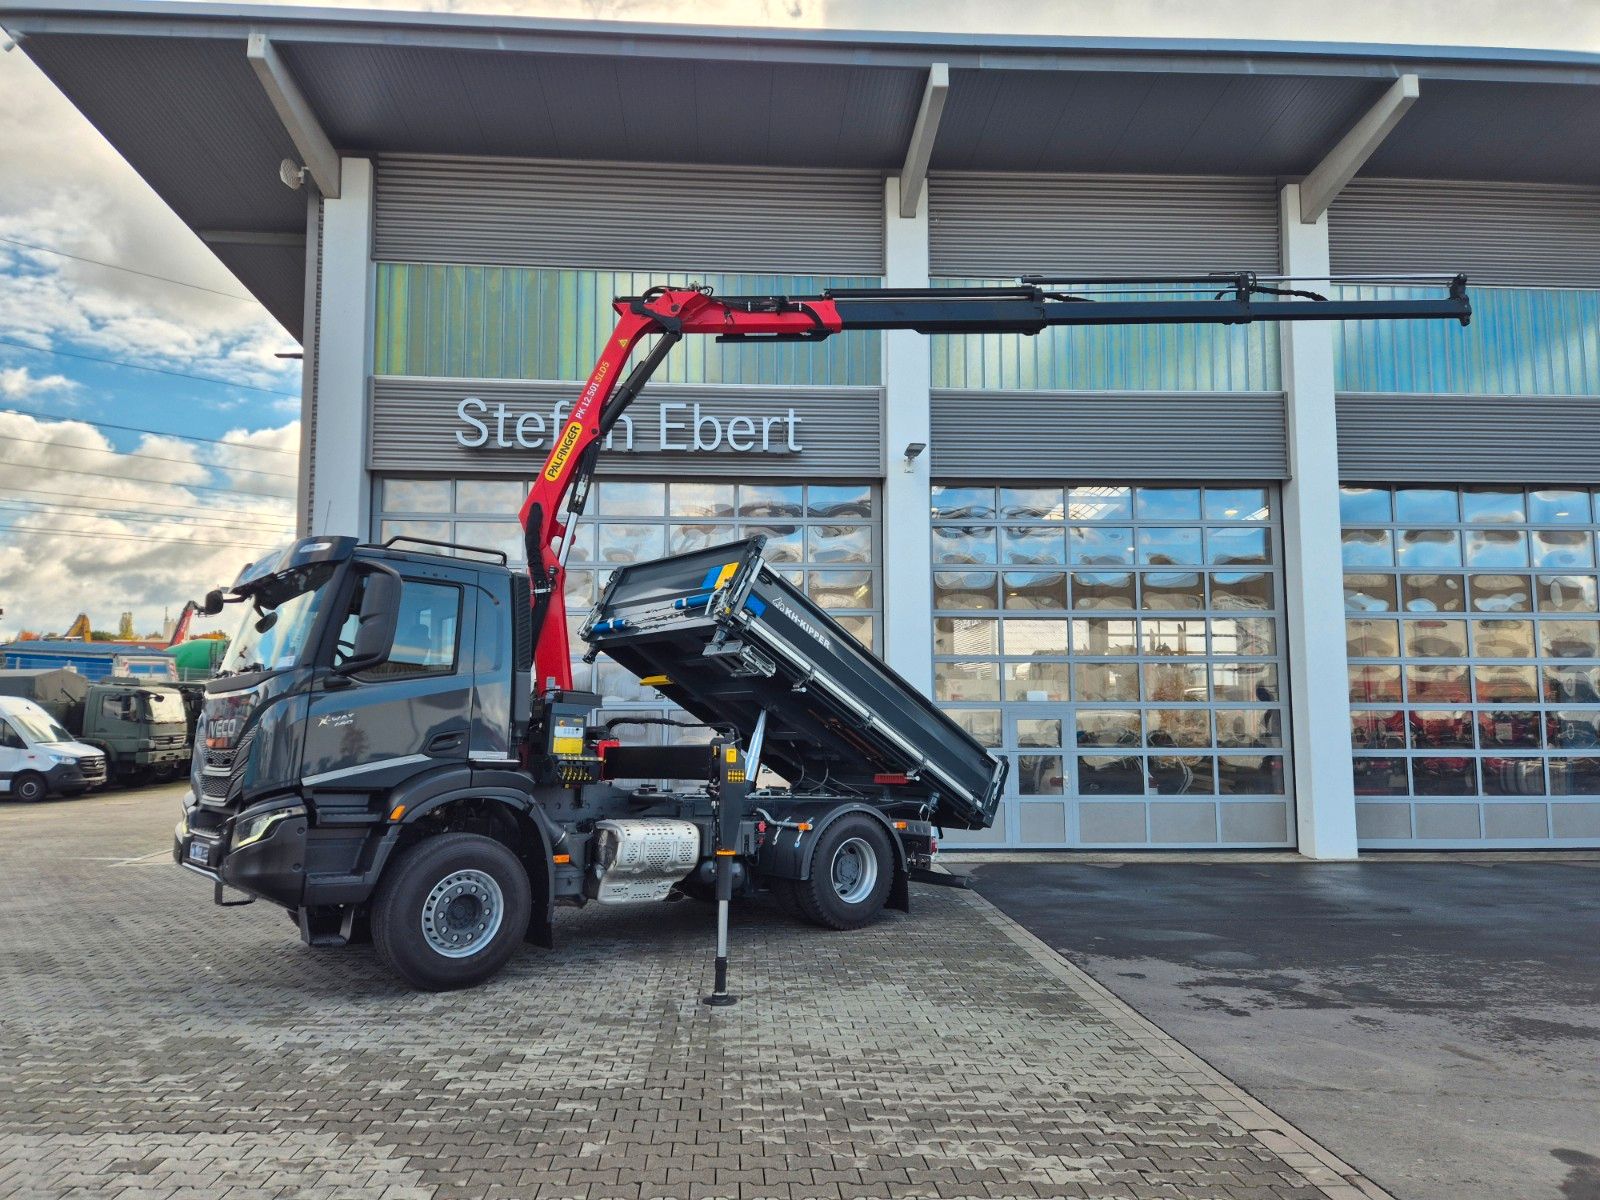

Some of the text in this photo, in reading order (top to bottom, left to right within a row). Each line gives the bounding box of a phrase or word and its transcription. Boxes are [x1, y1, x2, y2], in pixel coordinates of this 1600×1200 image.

[455, 397, 804, 452] Stefn Ebert
[575, 407, 587, 420] PK
[547, 425, 580, 478] PALFINGER
[785, 607, 830, 649] KH-KIPPER
[208, 718, 236, 738] IVECO
